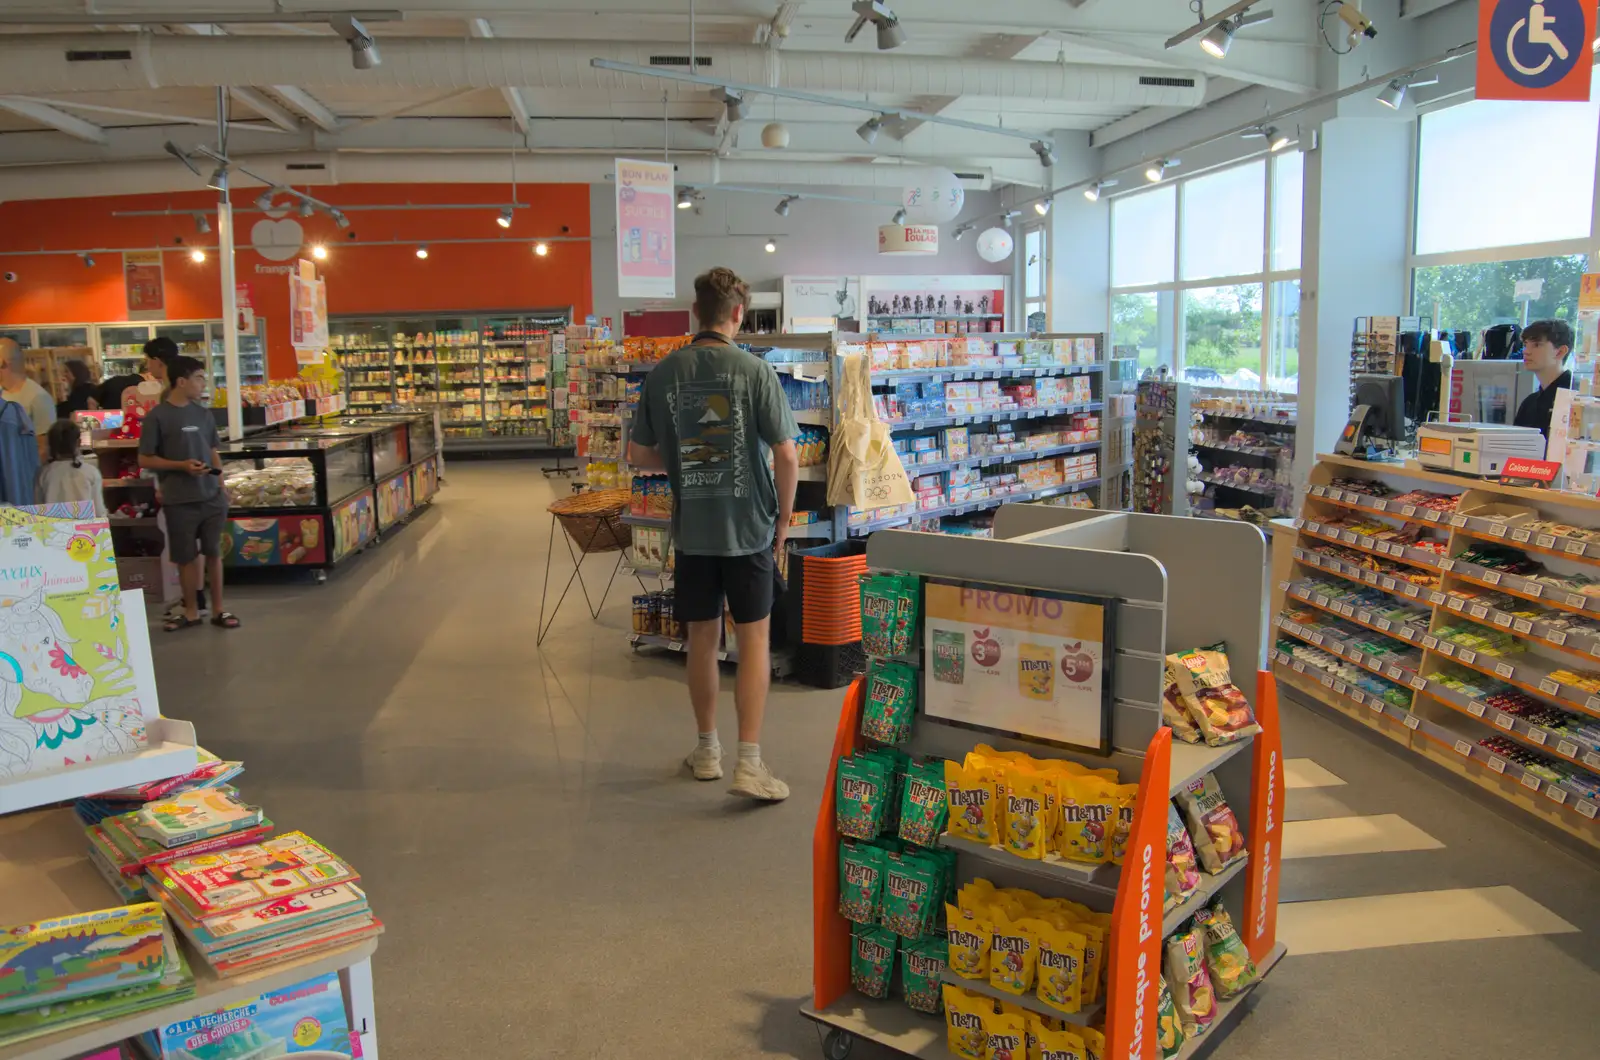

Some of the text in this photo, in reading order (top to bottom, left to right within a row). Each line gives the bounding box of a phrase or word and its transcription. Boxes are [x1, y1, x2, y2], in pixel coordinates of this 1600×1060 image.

[1508, 463, 1552, 476] Caisse fermée
[960, 587, 1064, 620] PROMO
[871, 679, 905, 700] m&m's
[909, 780, 947, 803] m&m's
[949, 788, 990, 806] m&m's
[1265, 750, 1276, 834] promo
[1007, 795, 1041, 817] m&m's
[1063, 803, 1114, 823] m&m's
[887, 872, 928, 896] m&m's
[1139, 843, 1152, 944] promo
[1255, 840, 1272, 940] Kiosque
[948, 930, 985, 951] m&m's
[992, 933, 1030, 954] m&m's
[1038, 946, 1078, 972] m&m's
[1128, 951, 1150, 1060] Kiosque
[199, 1007, 250, 1028] RECHERCHE
[190, 1022, 240, 1049] DES CHIOTS
